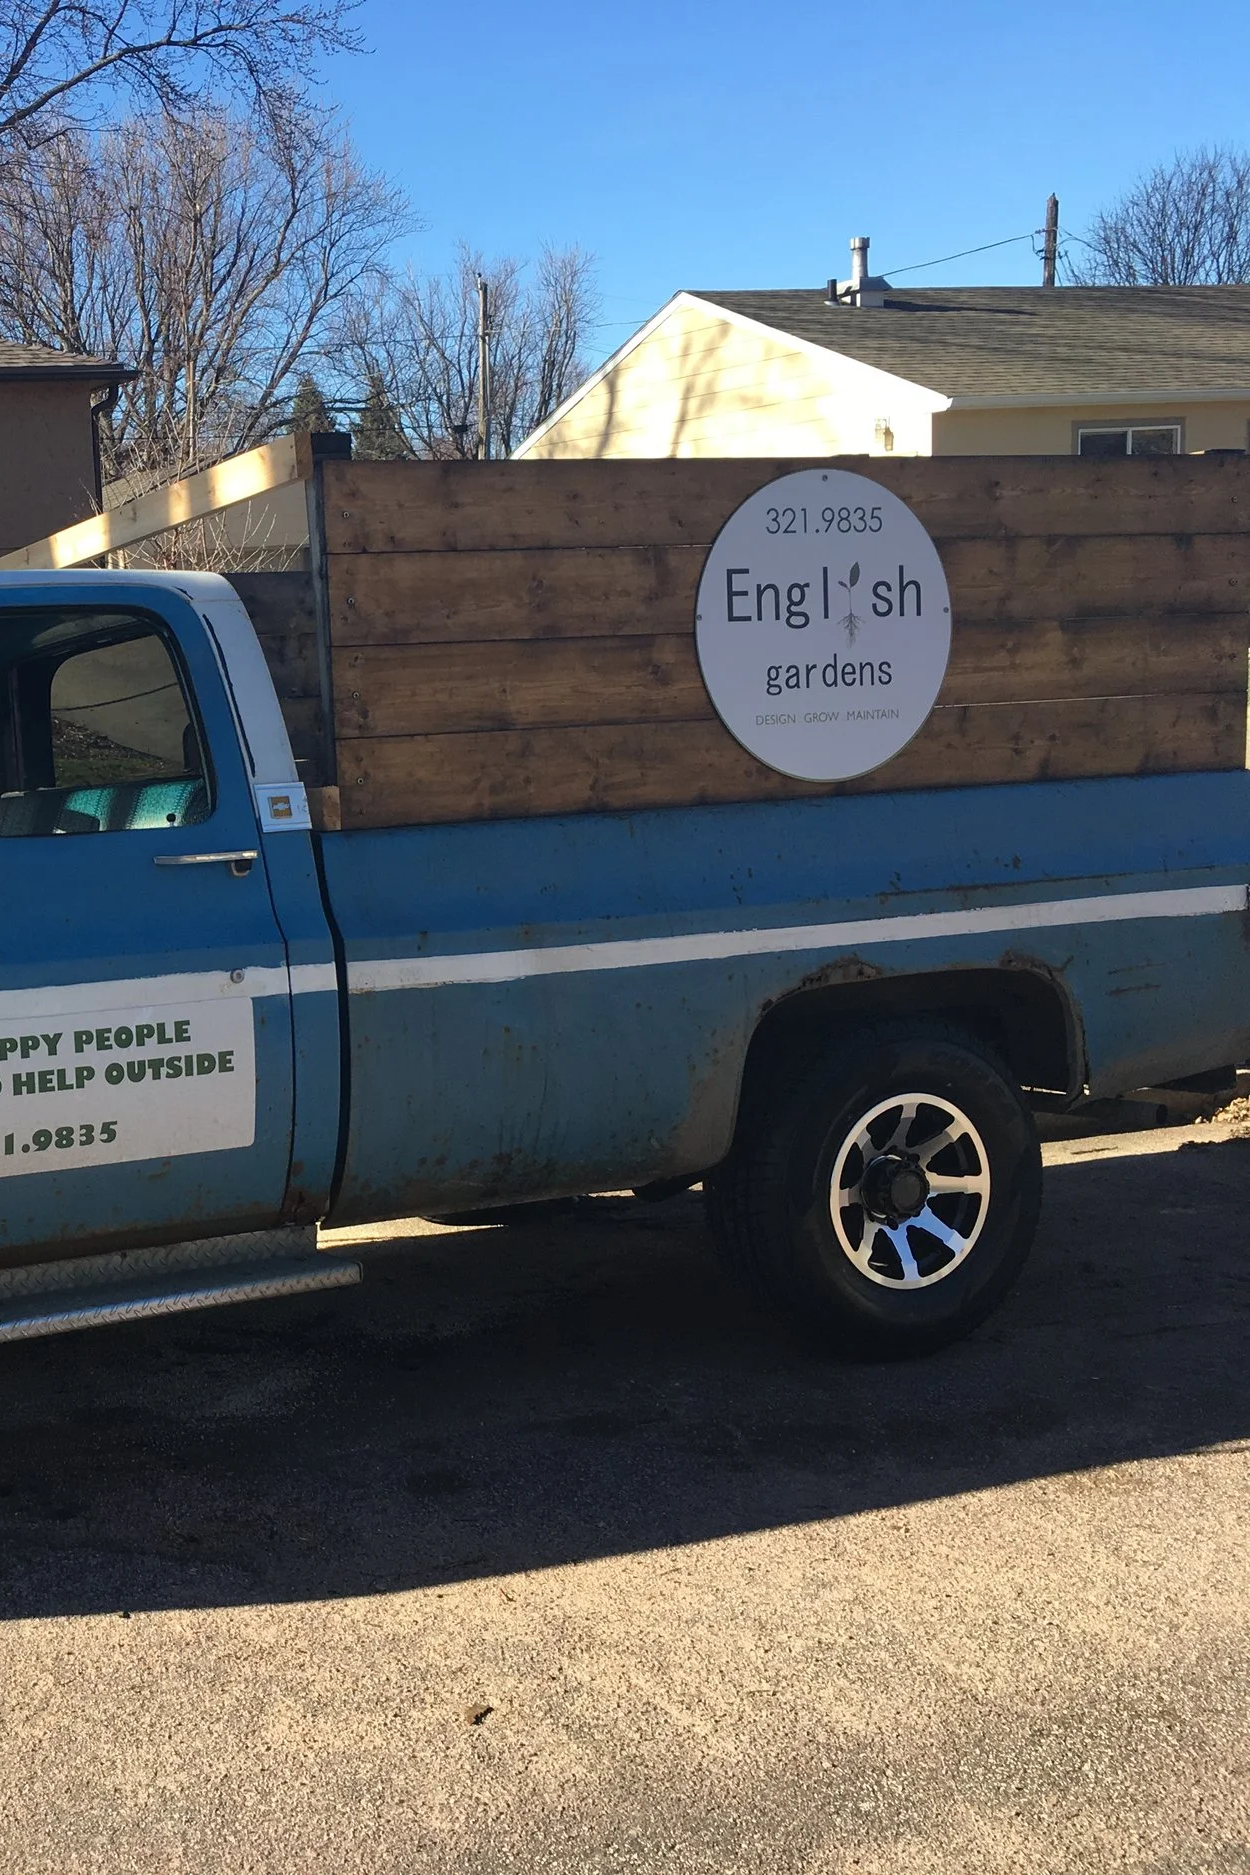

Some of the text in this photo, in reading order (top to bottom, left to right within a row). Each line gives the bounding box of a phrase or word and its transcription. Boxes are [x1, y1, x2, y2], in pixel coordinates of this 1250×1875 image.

[765, 506, 883, 535] 321.9835
[765, 653, 893, 696] gardens
[755, 708, 900, 726] DESIGN GROW MAINTAIN
[73, 1019, 191, 1054] PEOPLE
[12, 1065, 96, 1096] HELP
[104, 1050, 235, 1086] OUTSIDE
